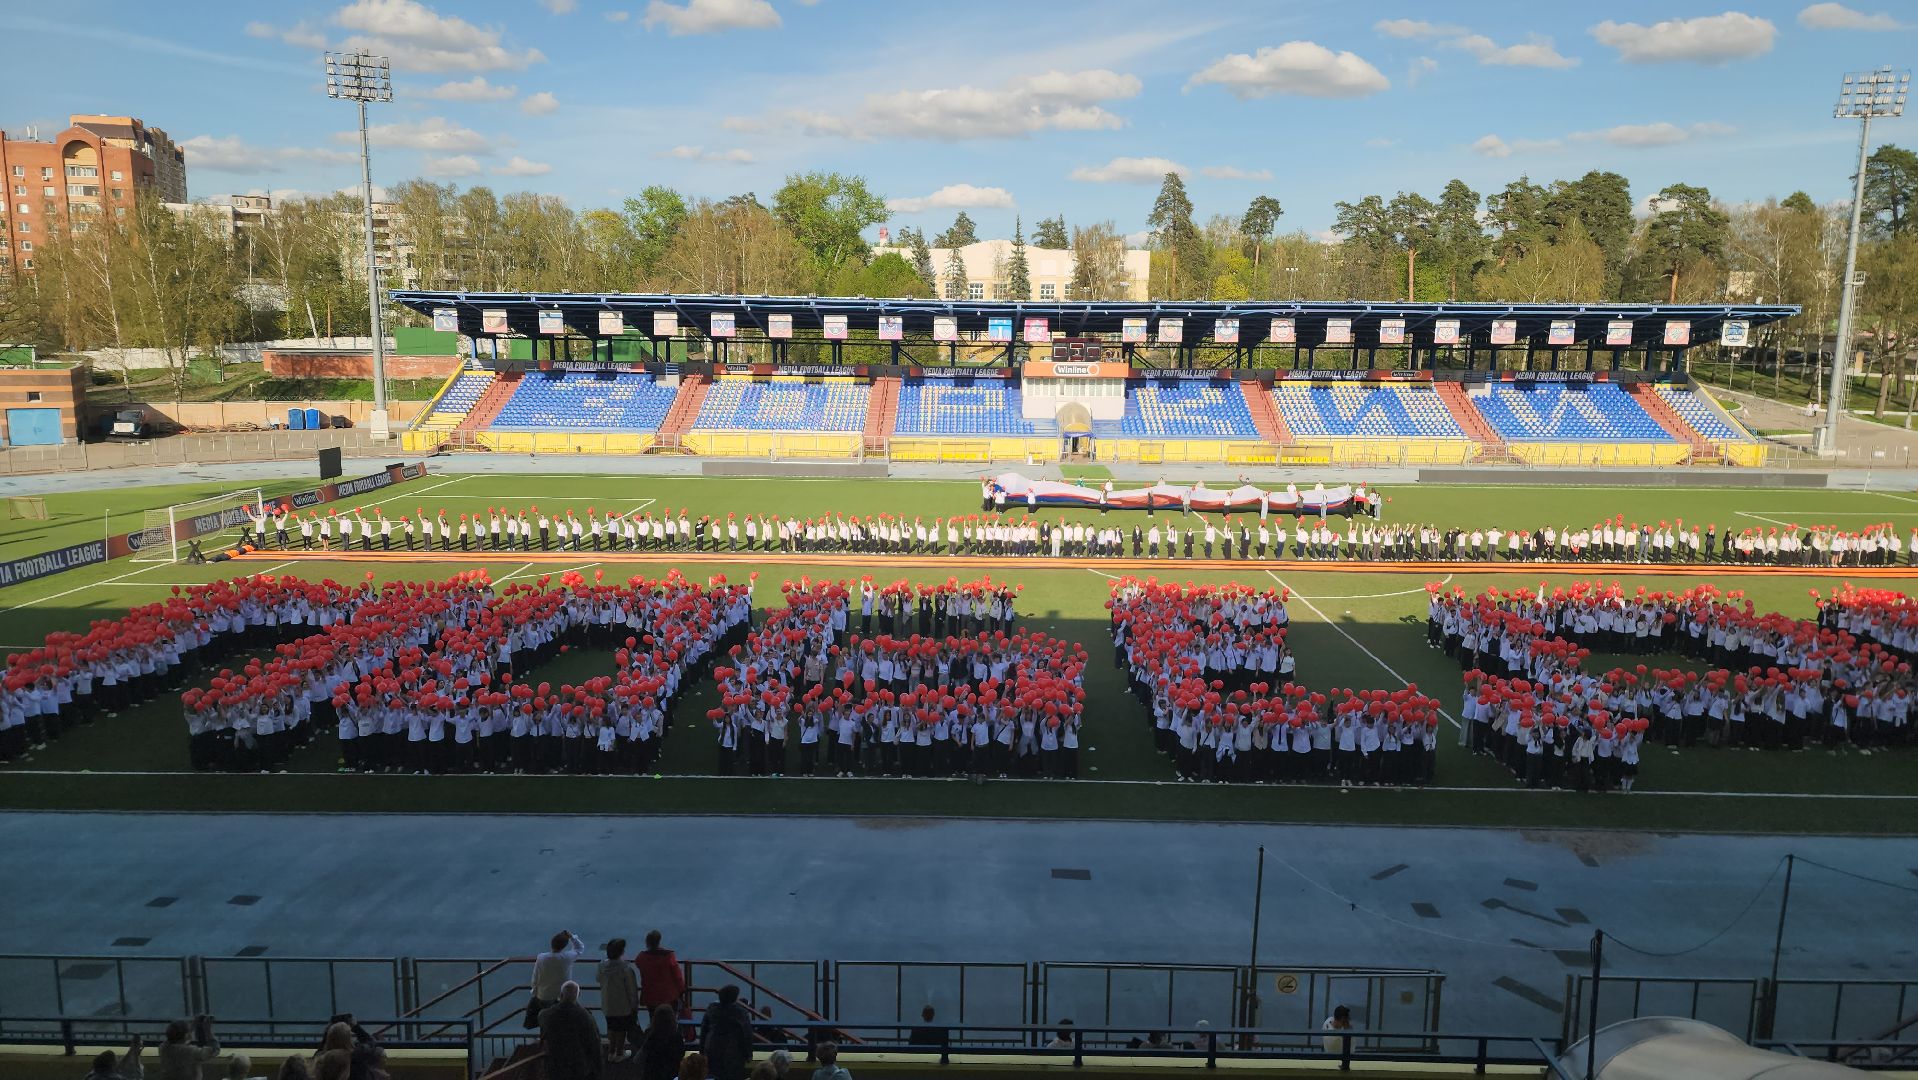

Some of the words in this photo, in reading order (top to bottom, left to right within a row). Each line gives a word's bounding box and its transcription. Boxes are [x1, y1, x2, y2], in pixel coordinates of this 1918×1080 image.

[553, 361, 572, 369] MEDIA
[574, 361, 606, 370] FOOTBALL
[606, 362, 632, 370] LEAGUE
[778, 365, 797, 374] MEDIA
[799, 365, 831, 374] FOOTBALL
[830, 366, 856, 375] LEAGUE
[1057, 364, 1087, 374] Winline
[922, 367, 942, 375] MEDIA
[943, 367, 973, 376] FOOTBALL
[975, 367, 999, 376] LEAGUE
[1140, 368, 1161, 377] MEDIA
[1161, 368, 1192, 377] FOOTBALL
[1193, 368, 1219, 377] LEAGUE
[1288, 370, 1309, 378] MEDIA
[1310, 370, 1341, 378] FOOTBALL
[1342, 370, 1368, 378] LEAGUE
[1514, 371, 1535, 380] MEDIA
[1536, 371, 1568, 380] FOOTBALL
[1569, 371, 1596, 380] LEAGUE
[338, 485, 355, 497] MEDIA
[353, 475, 375, 493] FOOTBALL
[374, 472, 392, 488] LEAGUE
[293, 493, 317, 506] Winline
[194, 515, 220, 533] MEDIA
[13, 551, 66, 580] FOOTBALL
[66, 542, 104, 566] LEAGUE
